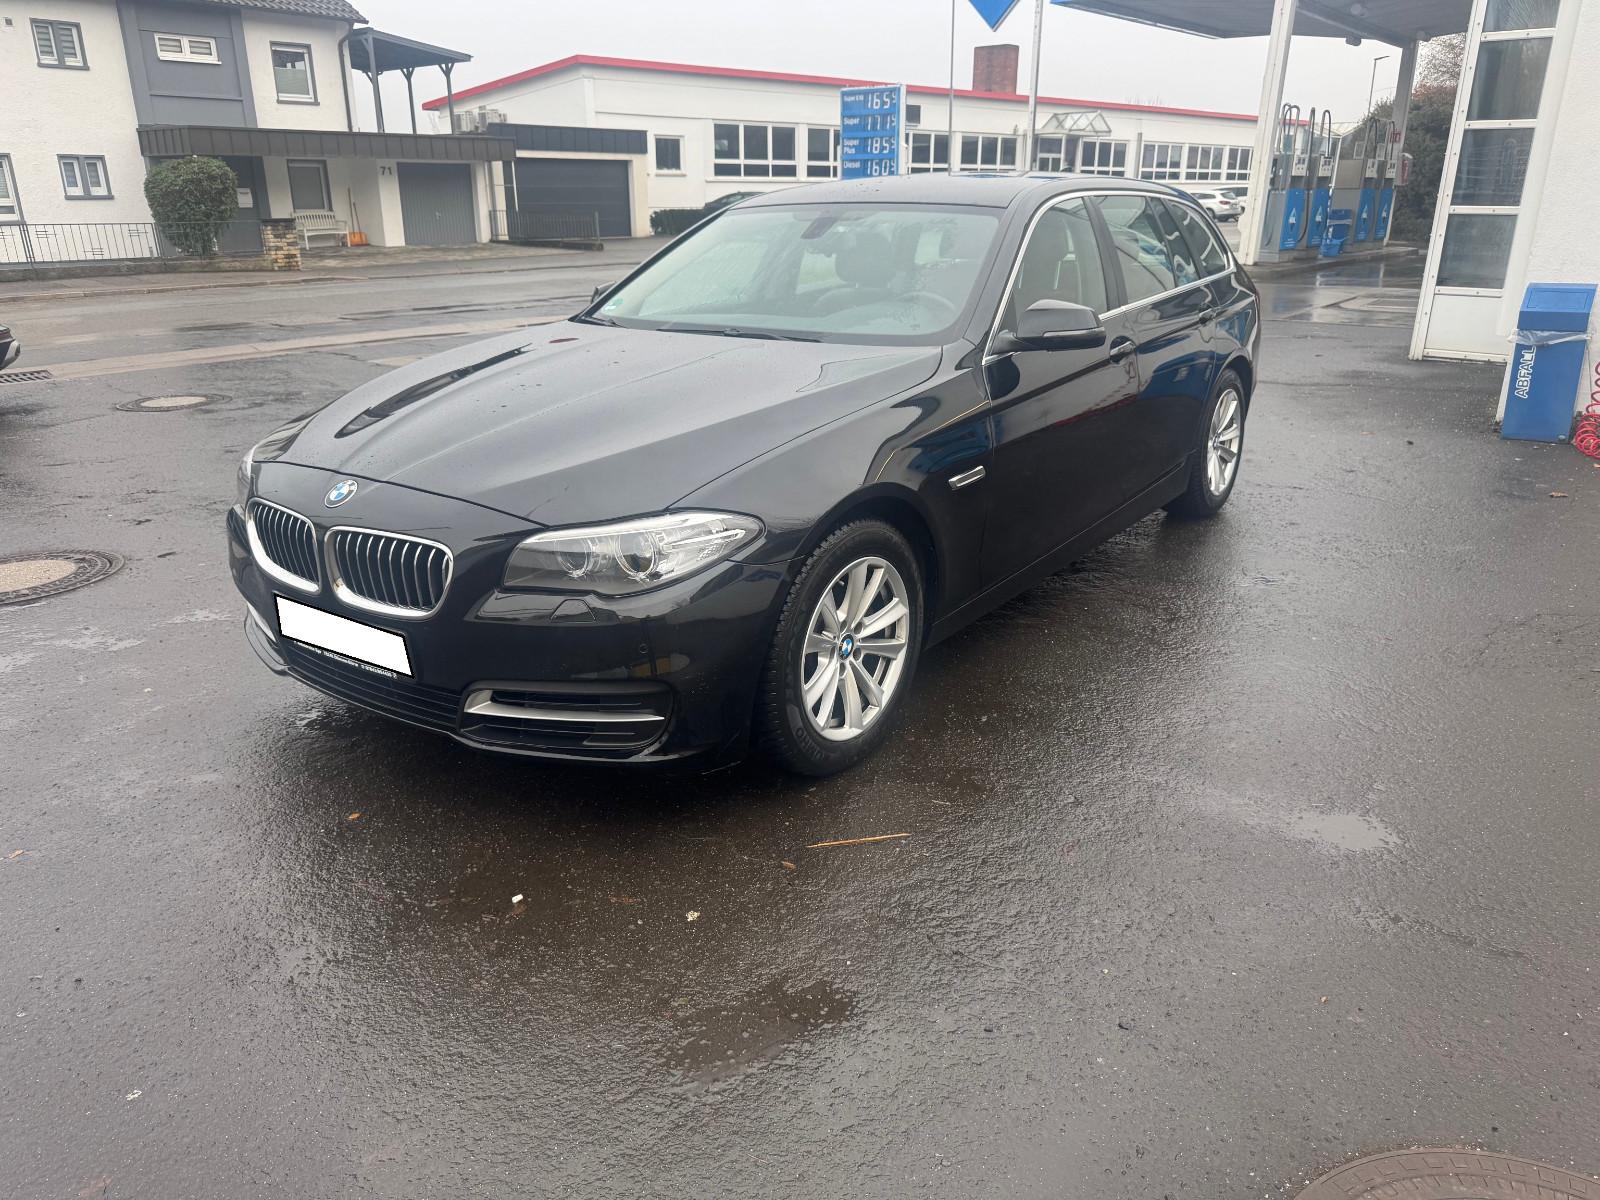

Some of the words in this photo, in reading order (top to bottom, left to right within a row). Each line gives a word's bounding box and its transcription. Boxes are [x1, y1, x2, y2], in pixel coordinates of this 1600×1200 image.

[844, 117, 859, 126] Super
[844, 139, 859, 147] Super
[380, 167, 392, 176] 71
[1514, 345, 1536, 399] ABFALL
